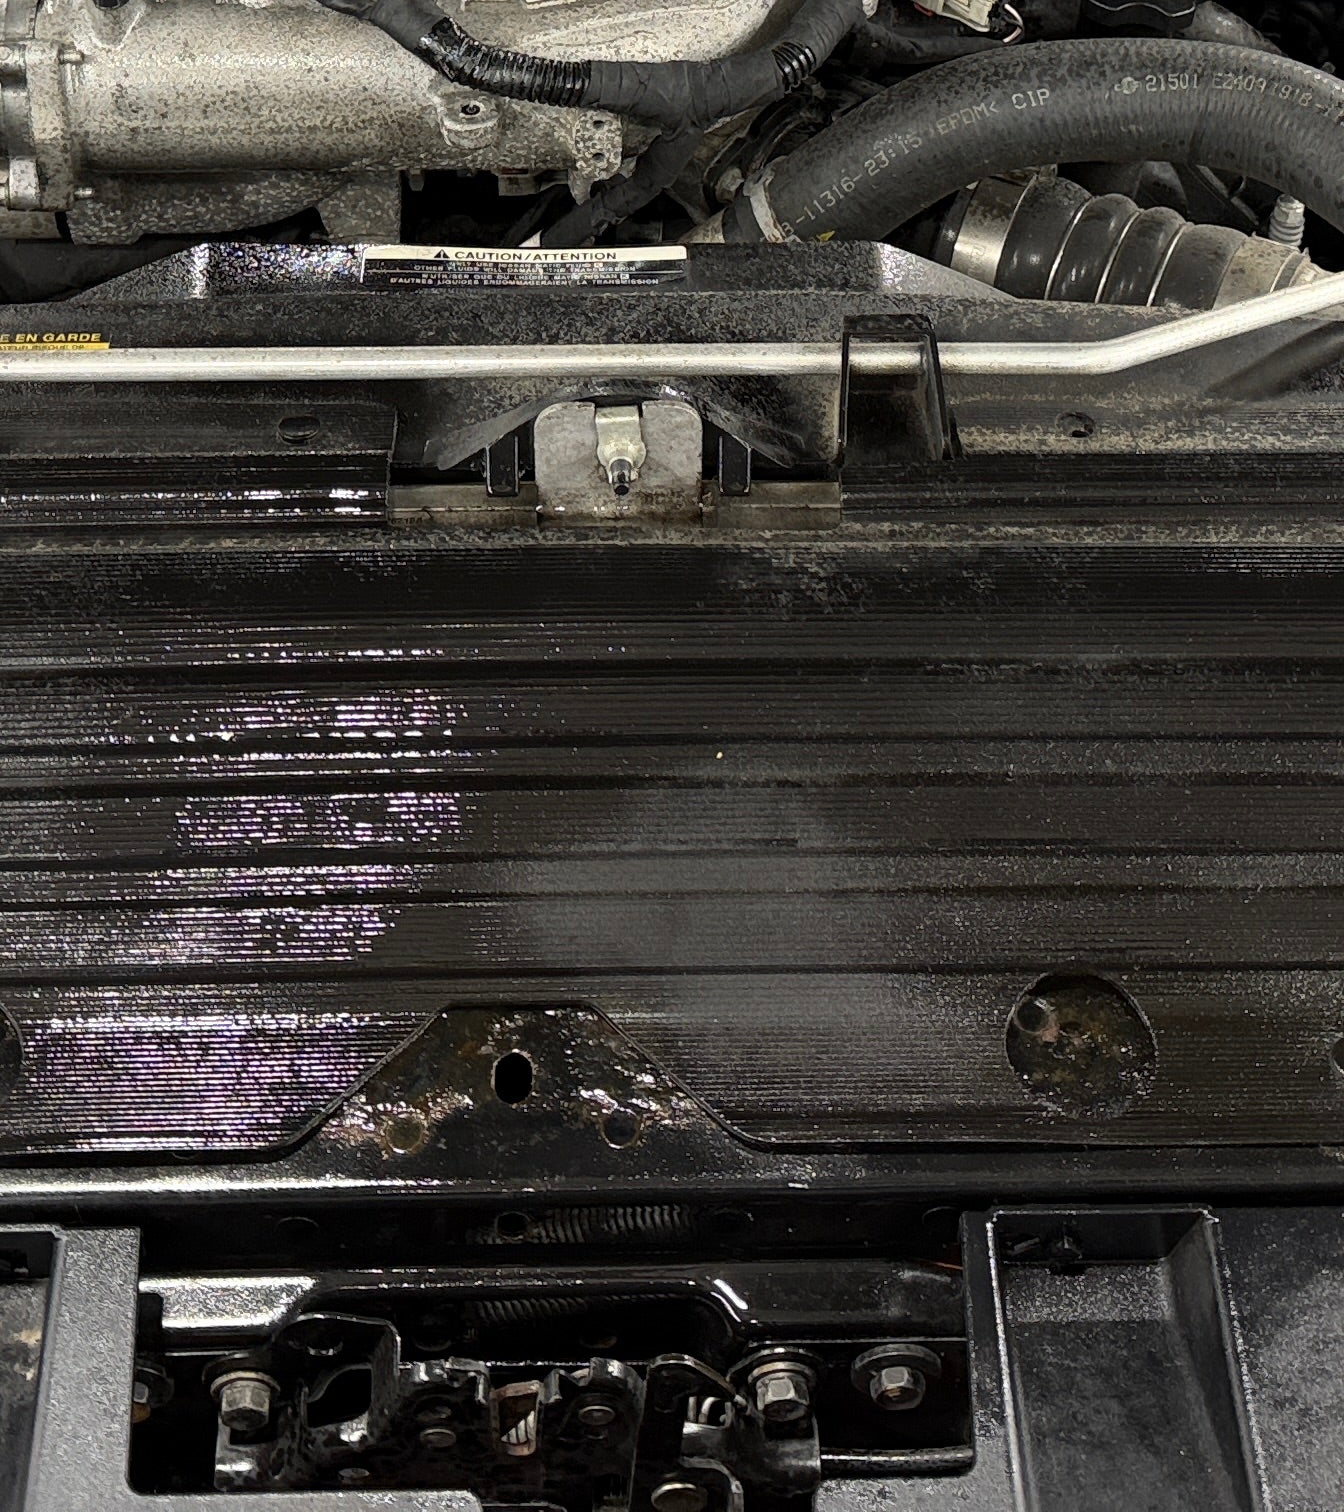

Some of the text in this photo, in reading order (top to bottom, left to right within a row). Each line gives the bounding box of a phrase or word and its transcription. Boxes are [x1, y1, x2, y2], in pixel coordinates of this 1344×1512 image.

[1011, 88, 1050, 110] CIP
[1145, 72, 1198, 92] 21501
[454, 251, 617, 261] CAUTION/ATTENTION
[15, 333, 38, 343] EN
[42, 332, 102, 343] GARDE
